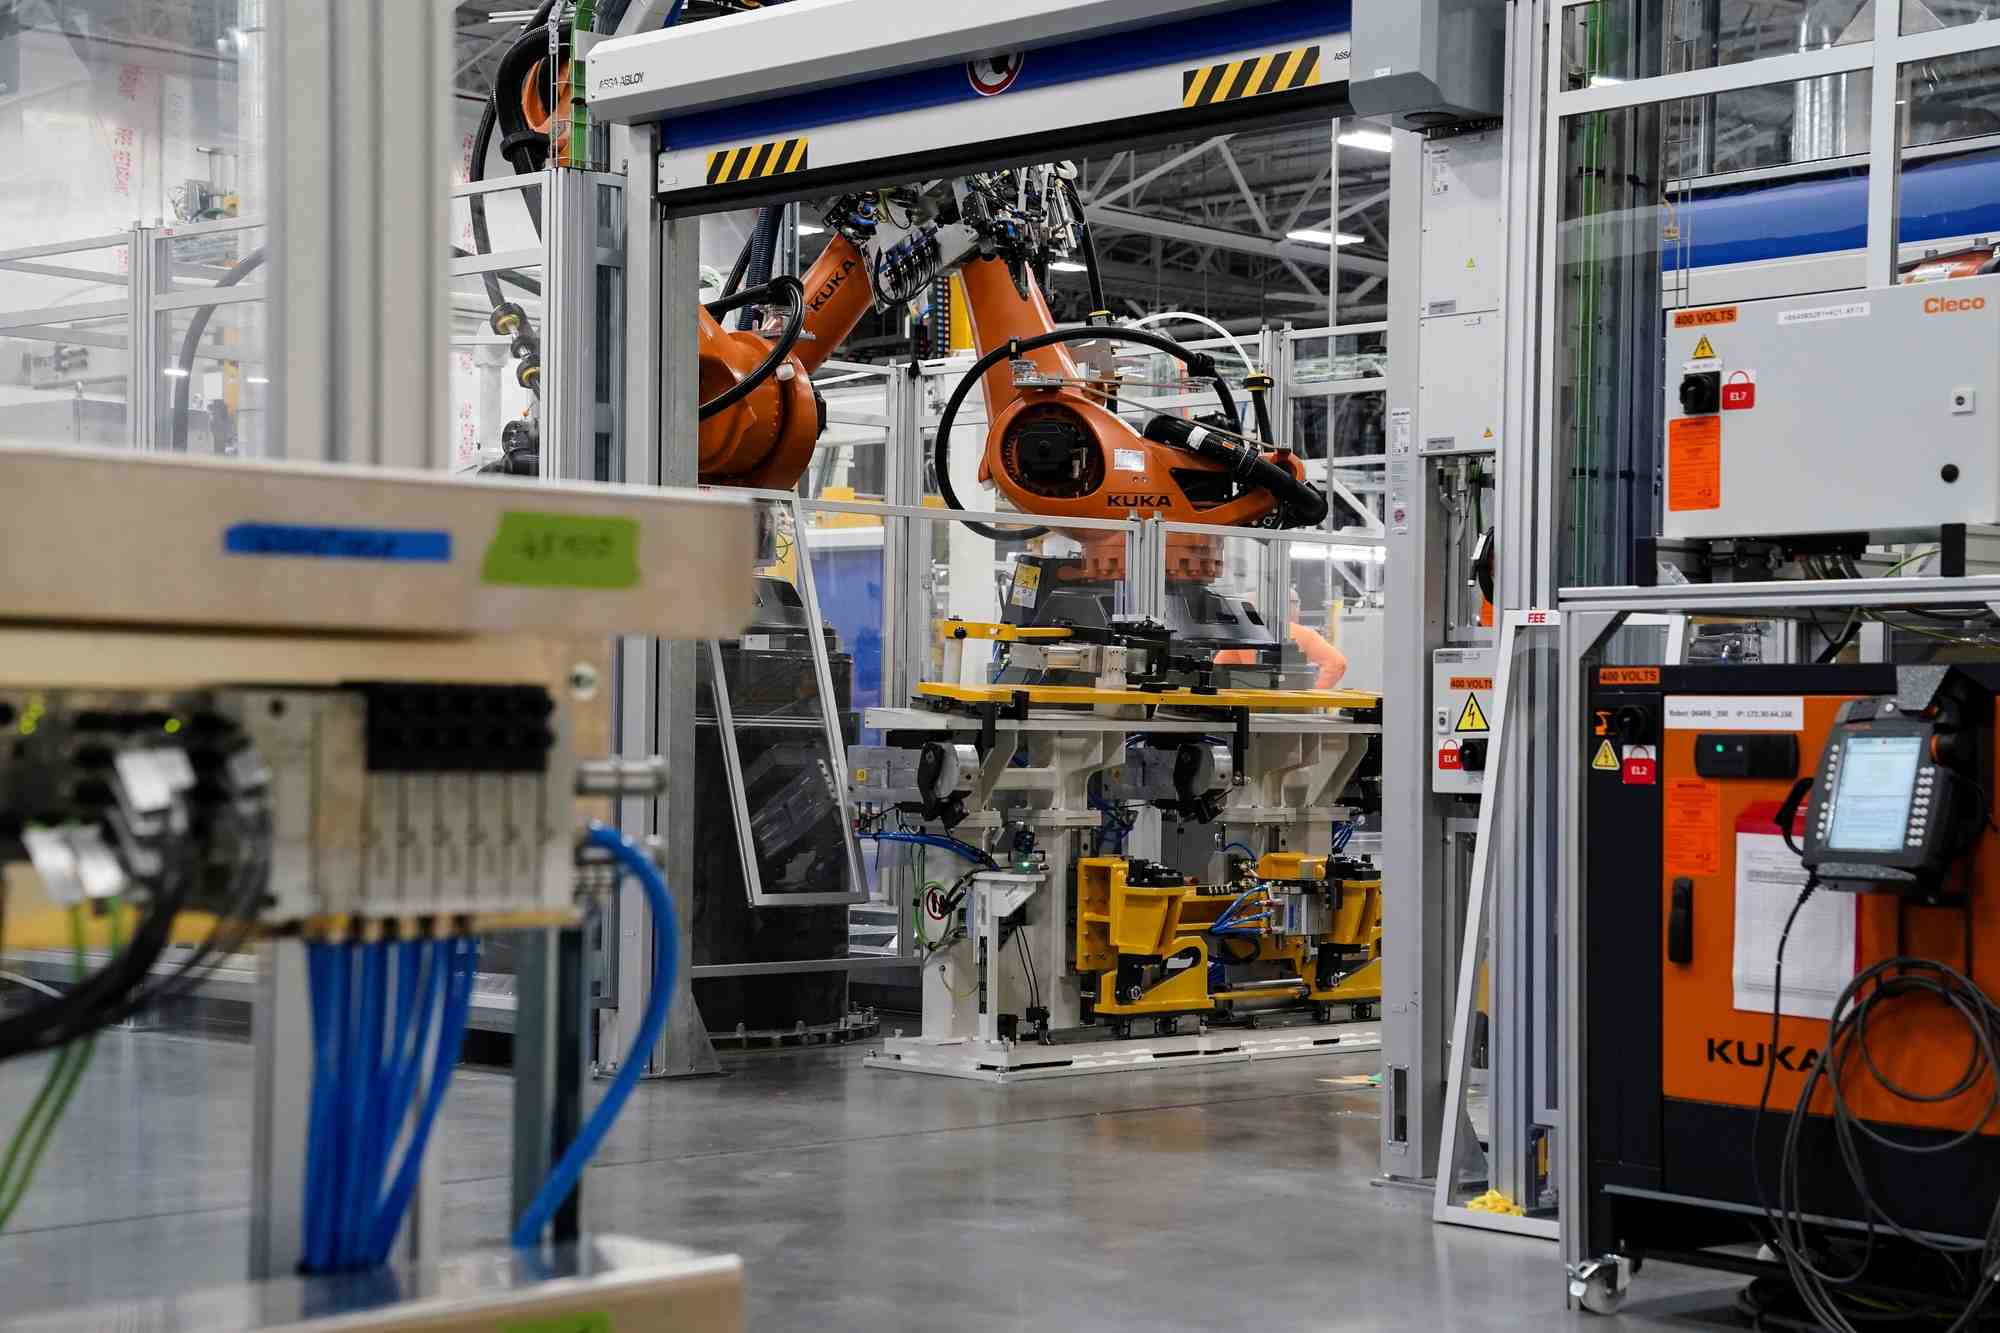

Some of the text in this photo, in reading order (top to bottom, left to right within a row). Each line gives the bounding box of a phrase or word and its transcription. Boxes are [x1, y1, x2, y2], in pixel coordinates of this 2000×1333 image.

[810, 259, 857, 312] KUKA
[1924, 297, 1985, 314] Cleco
[1696, 309, 1736, 323] VOLTS
[1107, 495, 1172, 507] KUKA
[1617, 670, 1657, 681] VOLTS
[1450, 679, 1465, 688] 400
[1706, 1038, 1820, 1072] KUKA
